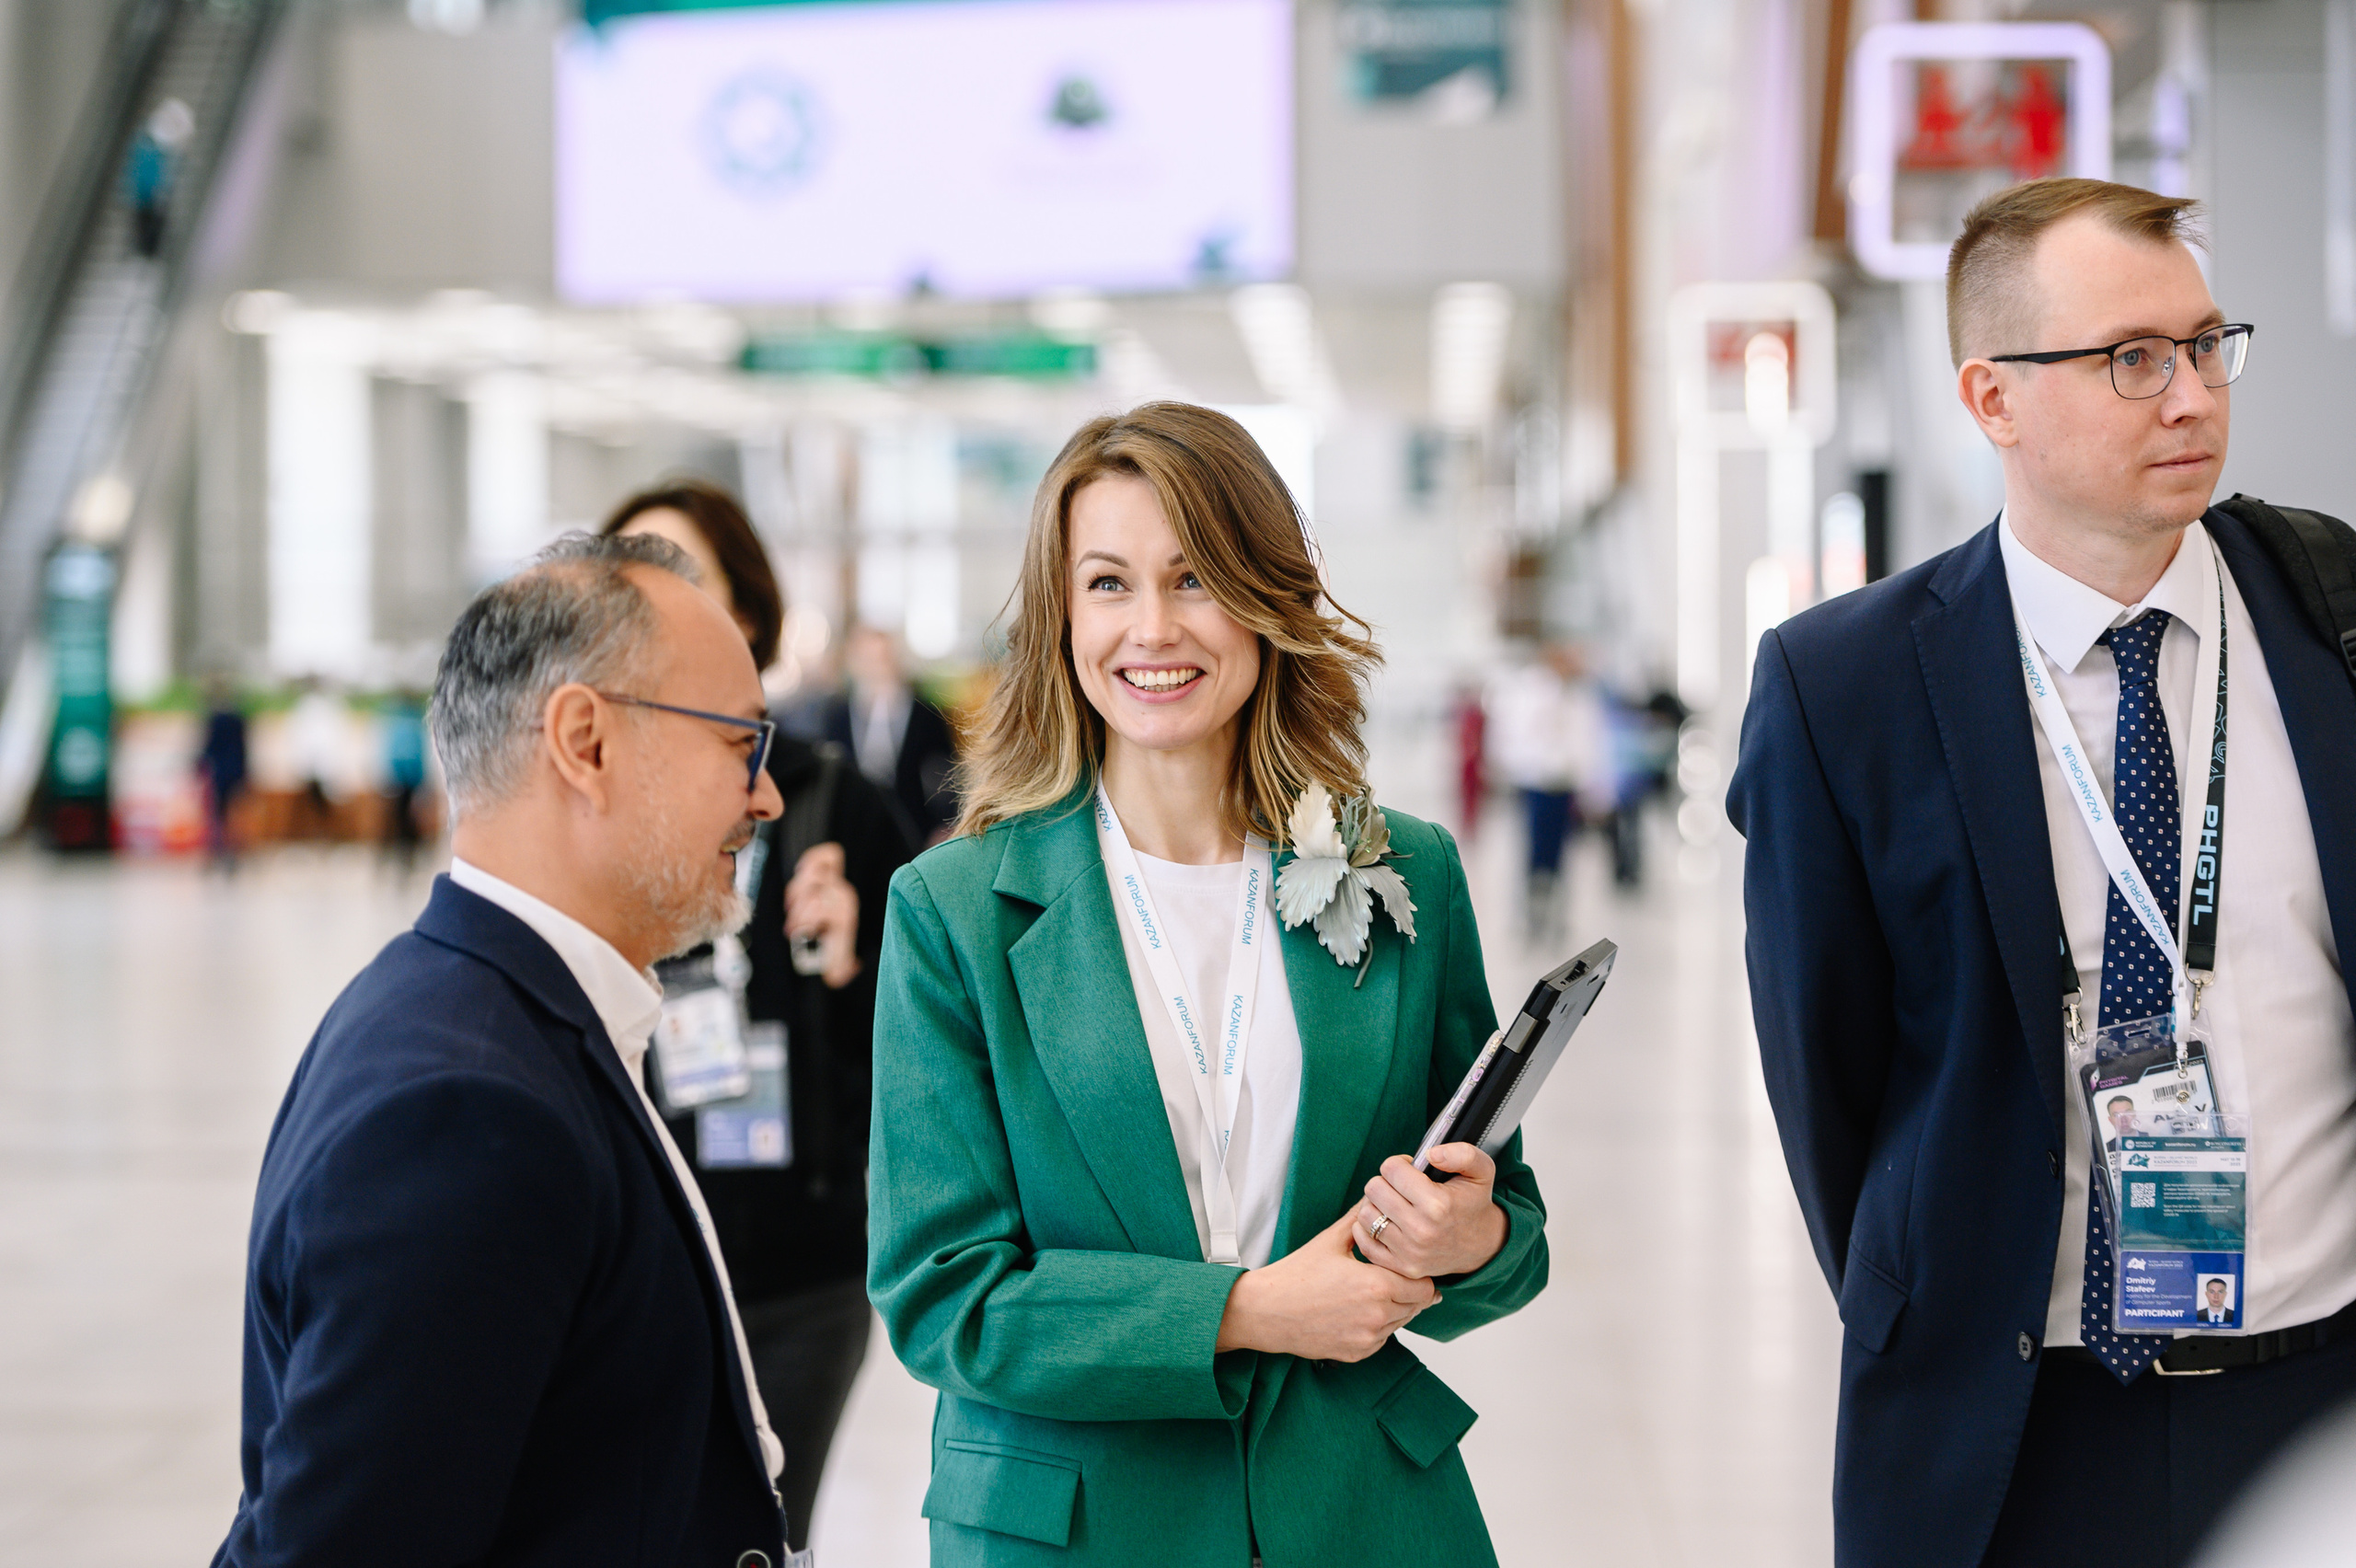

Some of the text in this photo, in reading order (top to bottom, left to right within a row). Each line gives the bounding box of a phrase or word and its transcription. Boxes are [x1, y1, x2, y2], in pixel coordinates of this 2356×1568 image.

[2015, 624, 2048, 698] KAZANFORU
[2061, 744, 2104, 824] KAZANFORUM
[2193, 804, 2219, 927] PHGTL
[1124, 874, 1161, 950] KAZANFORUM
[1242, 868, 1260, 945] KAZANFORUM
[2119, 869, 2169, 946] KAZANFORUM
[1172, 996, 1207, 1075] KAZANFORUM
[1223, 995, 1244, 1076] KAZANFORUM
[2124, 1309, 2185, 1318] PARTICIPANT
[2126, 1276, 2156, 1286] Dmitriy
